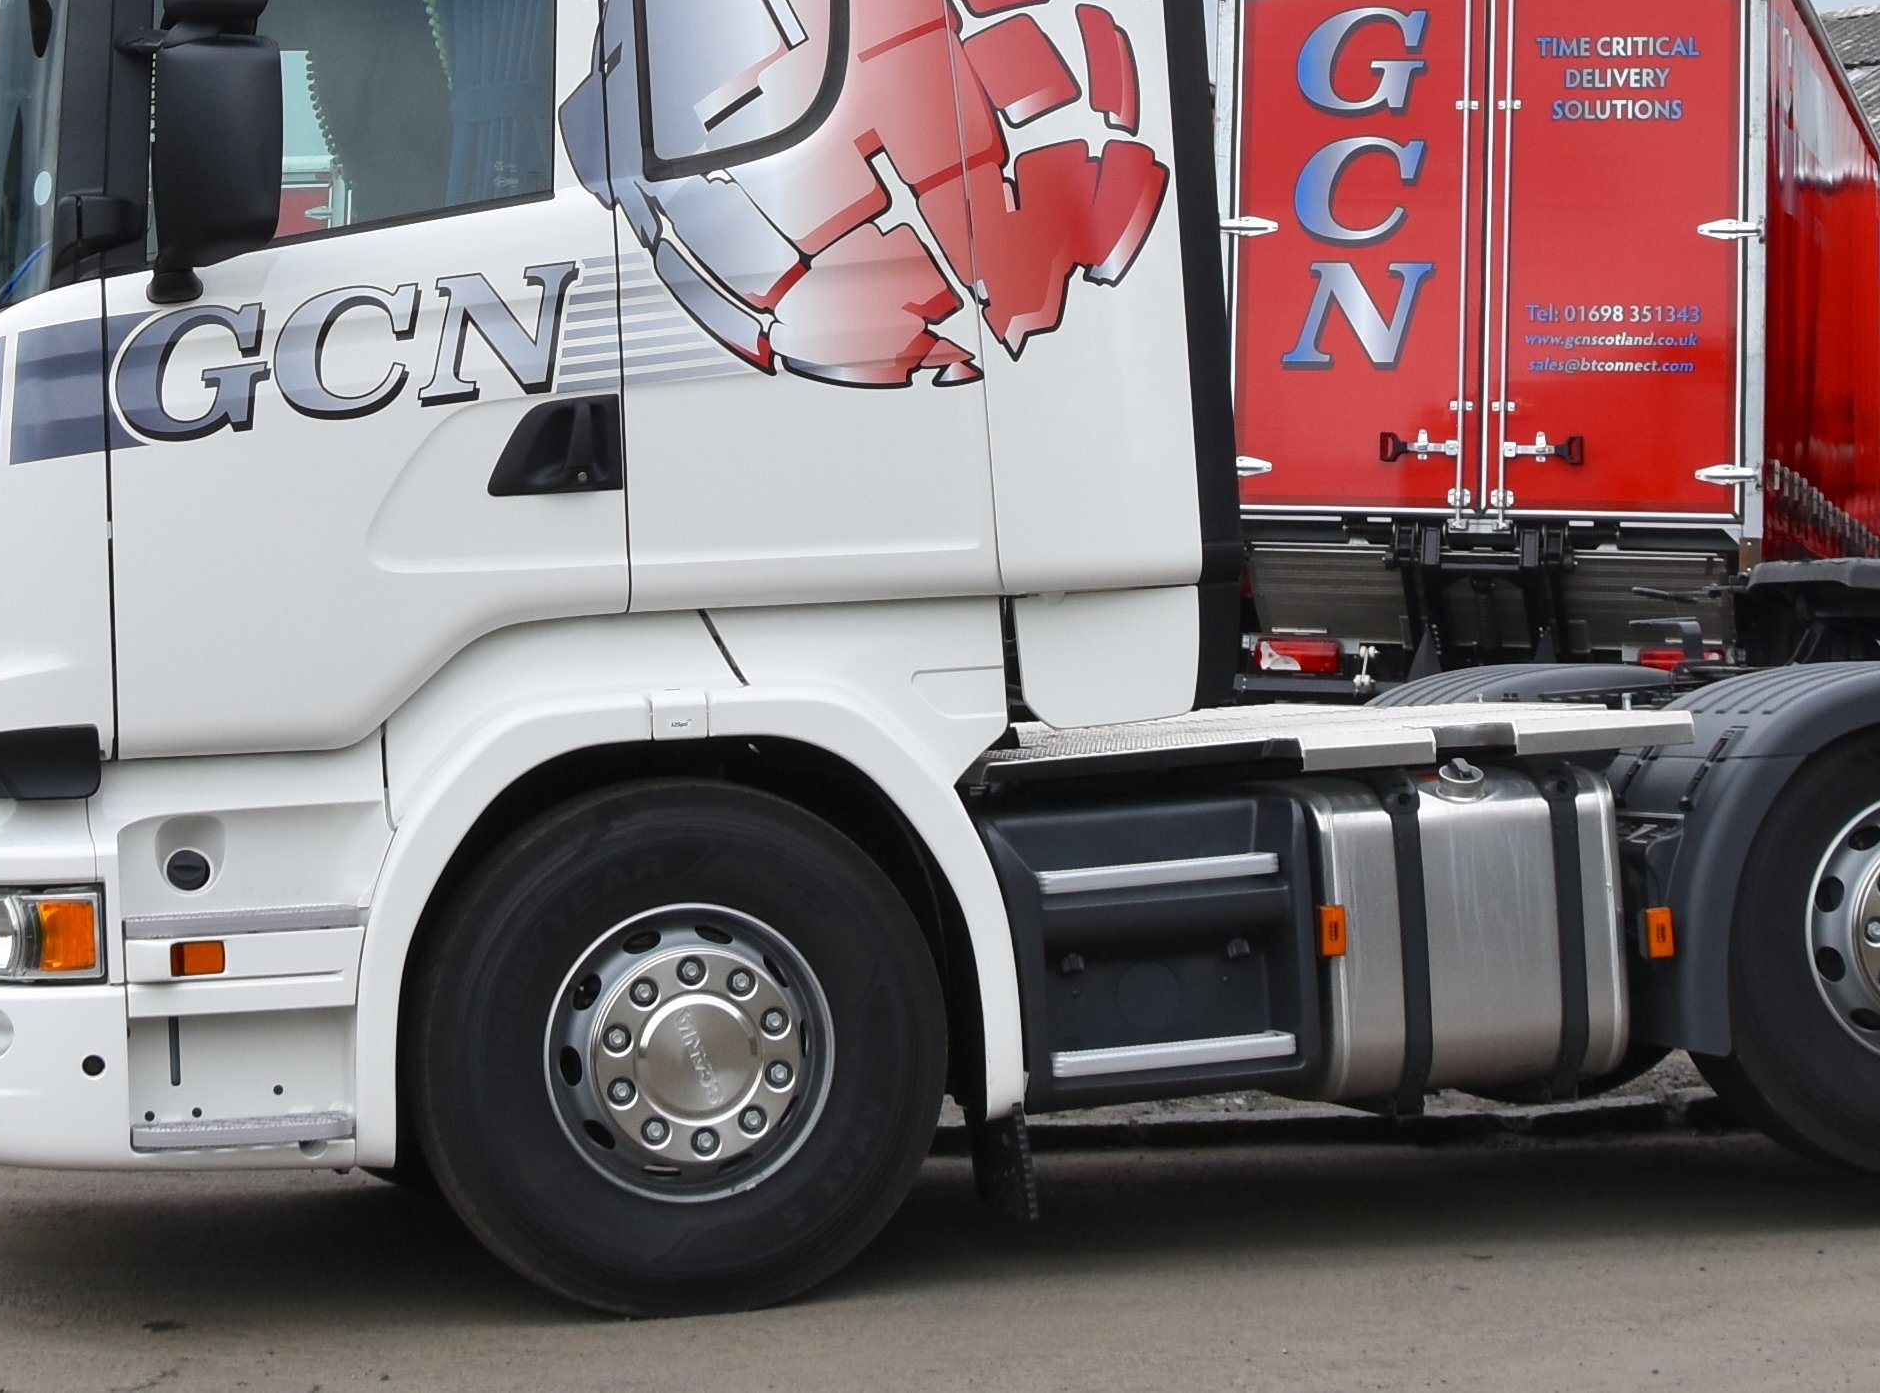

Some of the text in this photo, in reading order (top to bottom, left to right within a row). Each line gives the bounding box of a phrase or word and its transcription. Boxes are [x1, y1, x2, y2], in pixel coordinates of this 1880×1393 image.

[1536, 36, 1700, 57] TIME CRITICAL
[1565, 68, 1670, 88] DELIVERY
[1551, 99, 1682, 120] SOLUTIONS
[1281, 6, 1437, 370] GCN
[1525, 303, 1702, 323] Tel: 01698 351343
[1525, 332, 1698, 350] www.gcnscotland.co.uk
[114, 261, 579, 442] GCN
[1528, 357, 1694, 374] sales@btconnect.com
